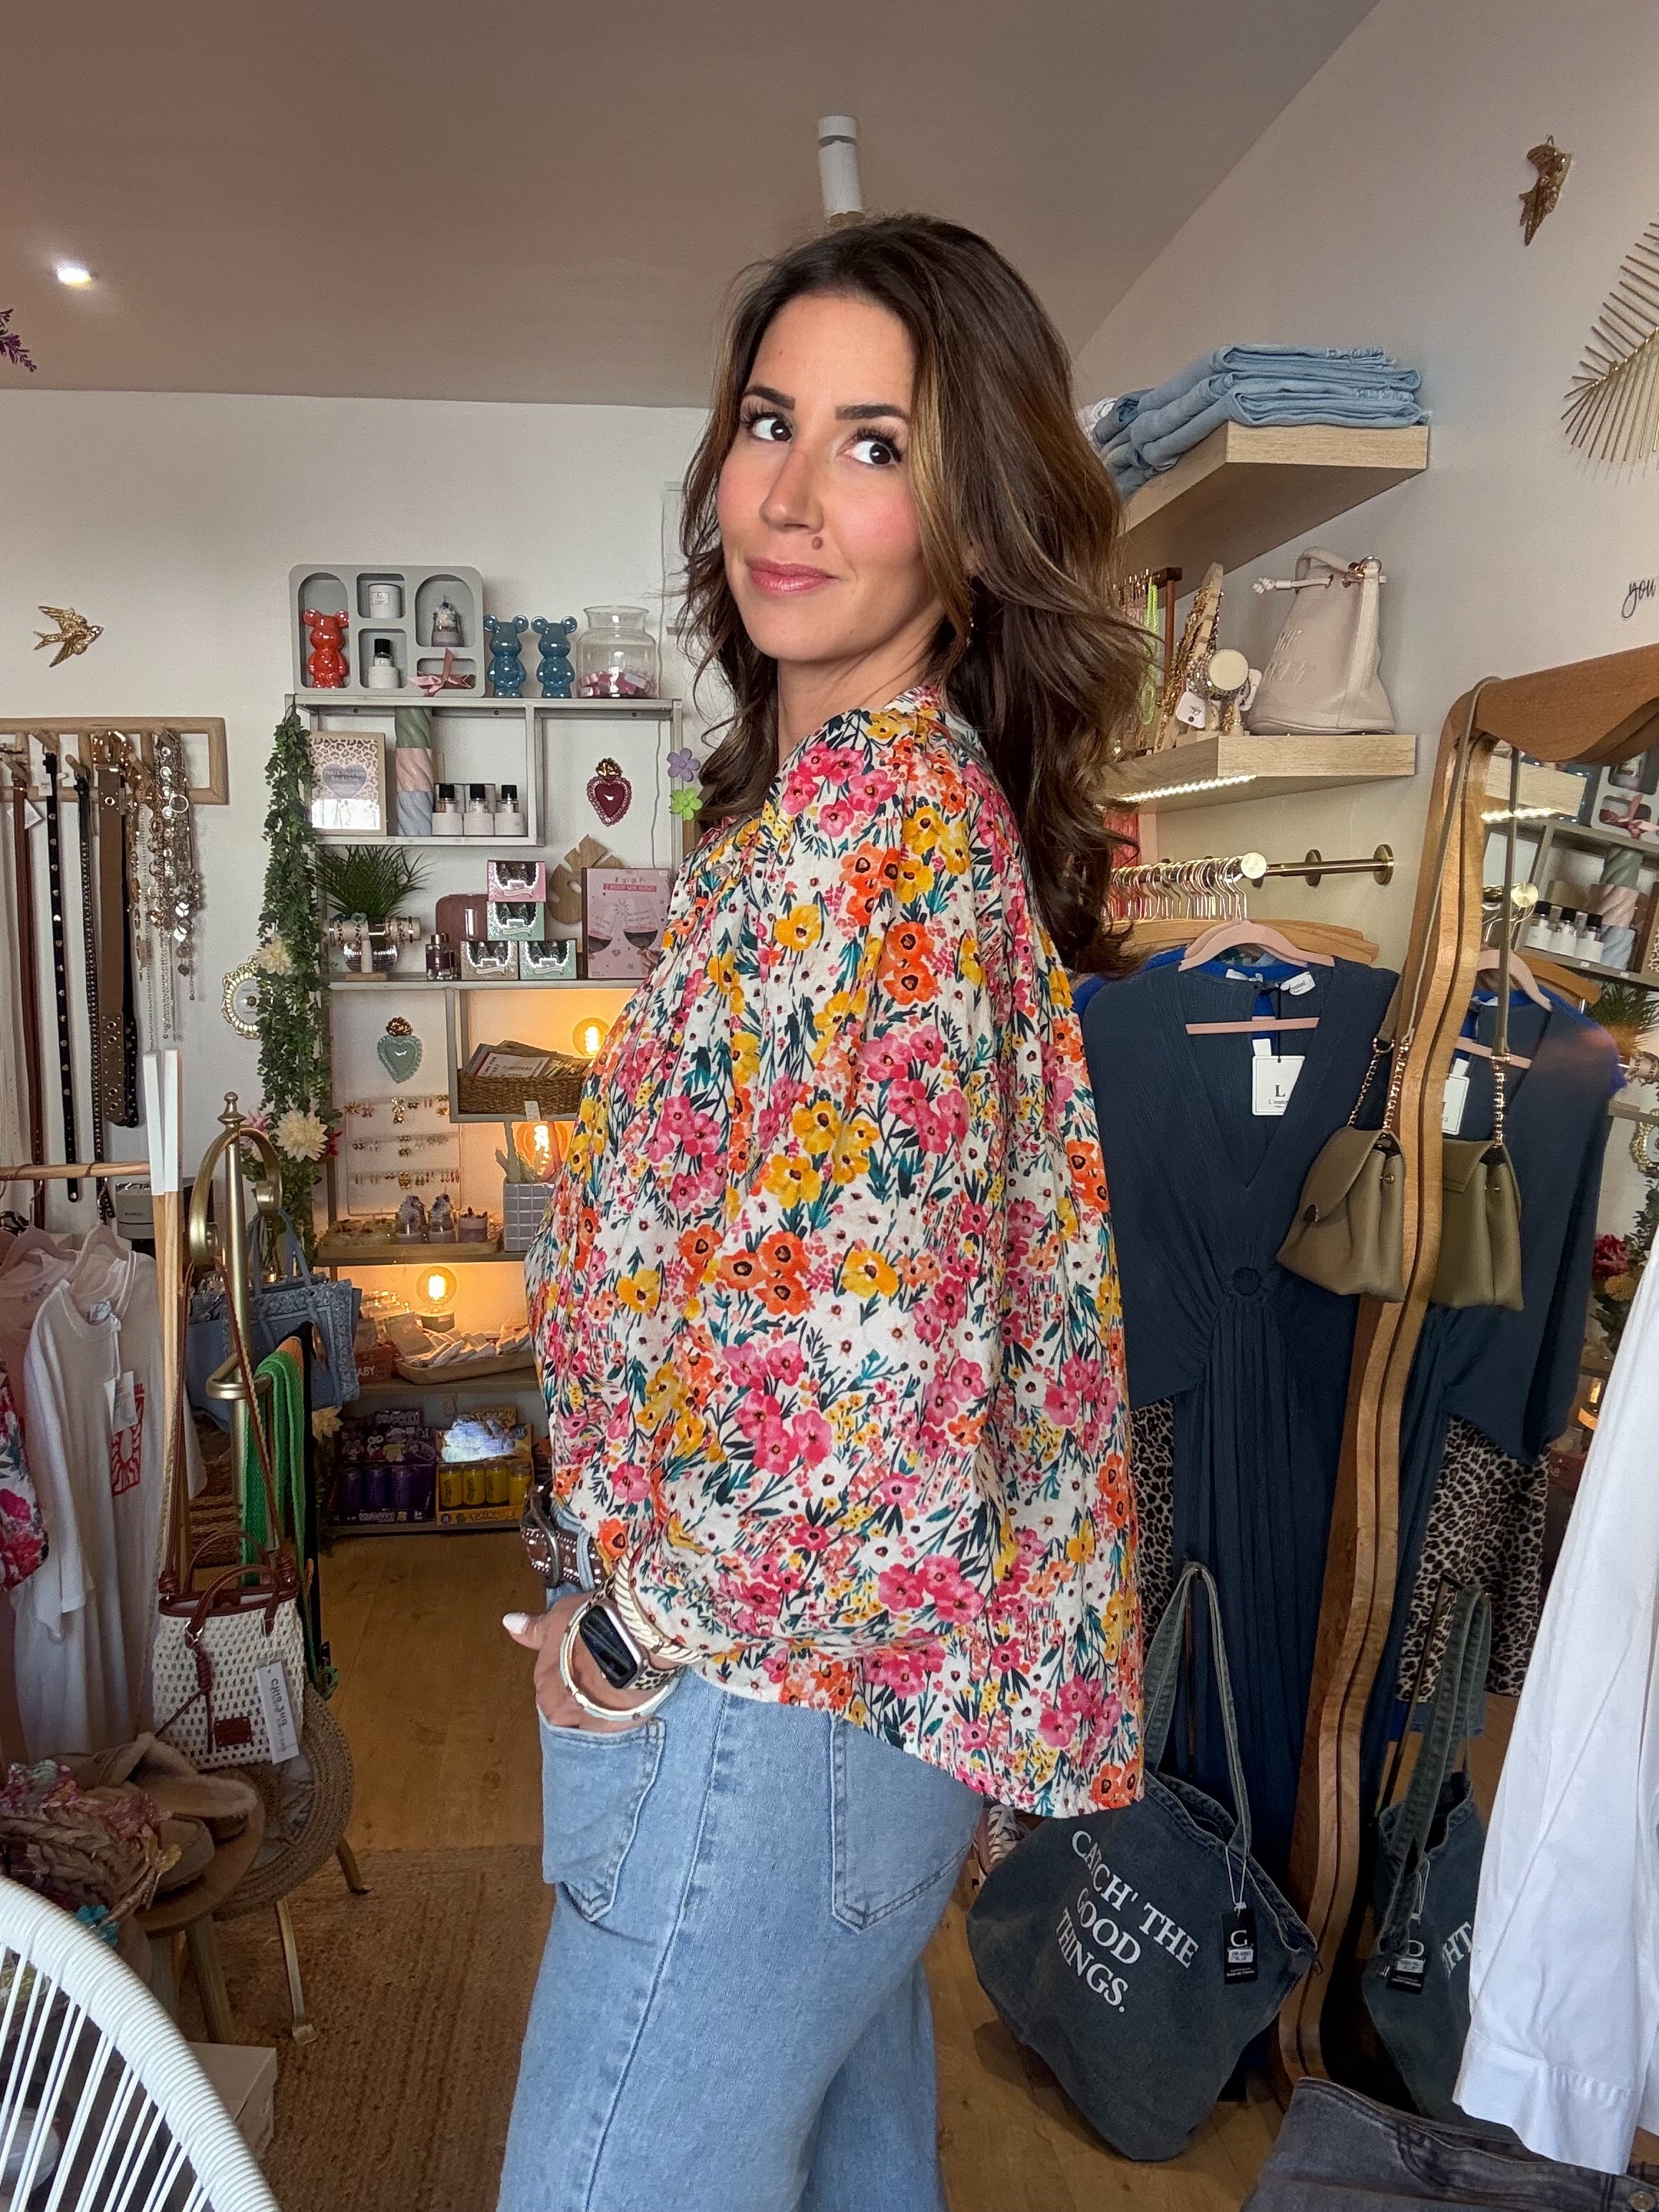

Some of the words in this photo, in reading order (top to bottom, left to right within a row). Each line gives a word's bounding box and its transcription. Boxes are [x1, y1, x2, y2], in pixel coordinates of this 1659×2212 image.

[1622, 579, 1656, 618] you
[1275, 1085, 1286, 1097] L
[356, 1365, 375, 1376] ABY
[1072, 1830, 1139, 1911] CATCH'
[1138, 1902, 1199, 1968] THE
[1077, 1888, 1141, 1964] GOOD
[1231, 1930, 1248, 1947] G
[1056, 1907, 1128, 2013] THINGS.
